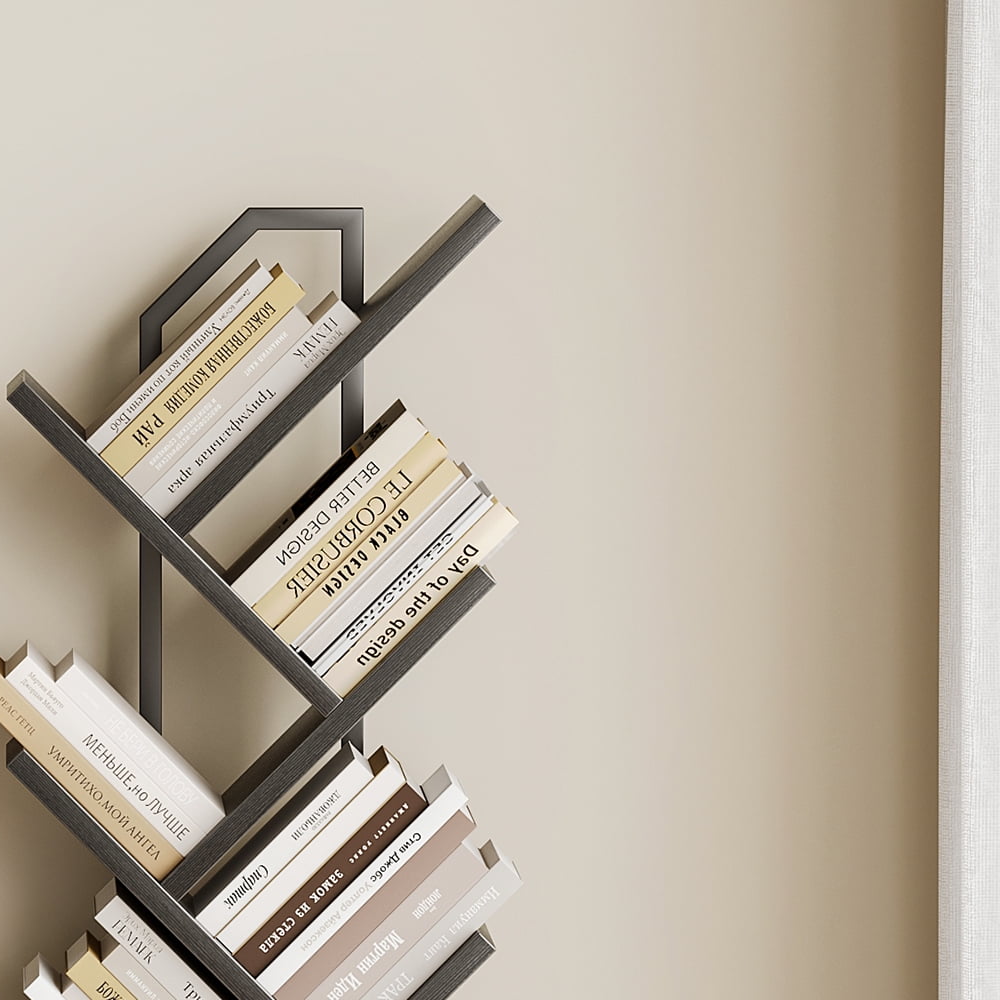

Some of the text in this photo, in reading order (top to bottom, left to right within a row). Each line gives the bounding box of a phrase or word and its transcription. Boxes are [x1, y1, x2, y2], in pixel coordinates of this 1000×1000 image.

[179, 322, 222, 363] Уличный
[131, 301, 277, 448] БОЖЕСТВЕННАЯ КОМЕДИЯ РАЙ
[165, 359, 182, 377] кот
[110, 412, 132, 434] Боб
[167, 388, 277, 494] Триумфальная арка
[145, 797, 191, 842] ЛУЧШЕ
[126, 826, 161, 861] АНГЕЛ
[398, 832, 422, 854] Стив
[369, 851, 401, 883] Джобс
[223, 864, 269, 910] Спартак
[308, 869, 344, 904] замок
[294, 901, 311, 918] из
[258, 917, 296, 953] стекла
[356, 929, 405, 975] Мартин
